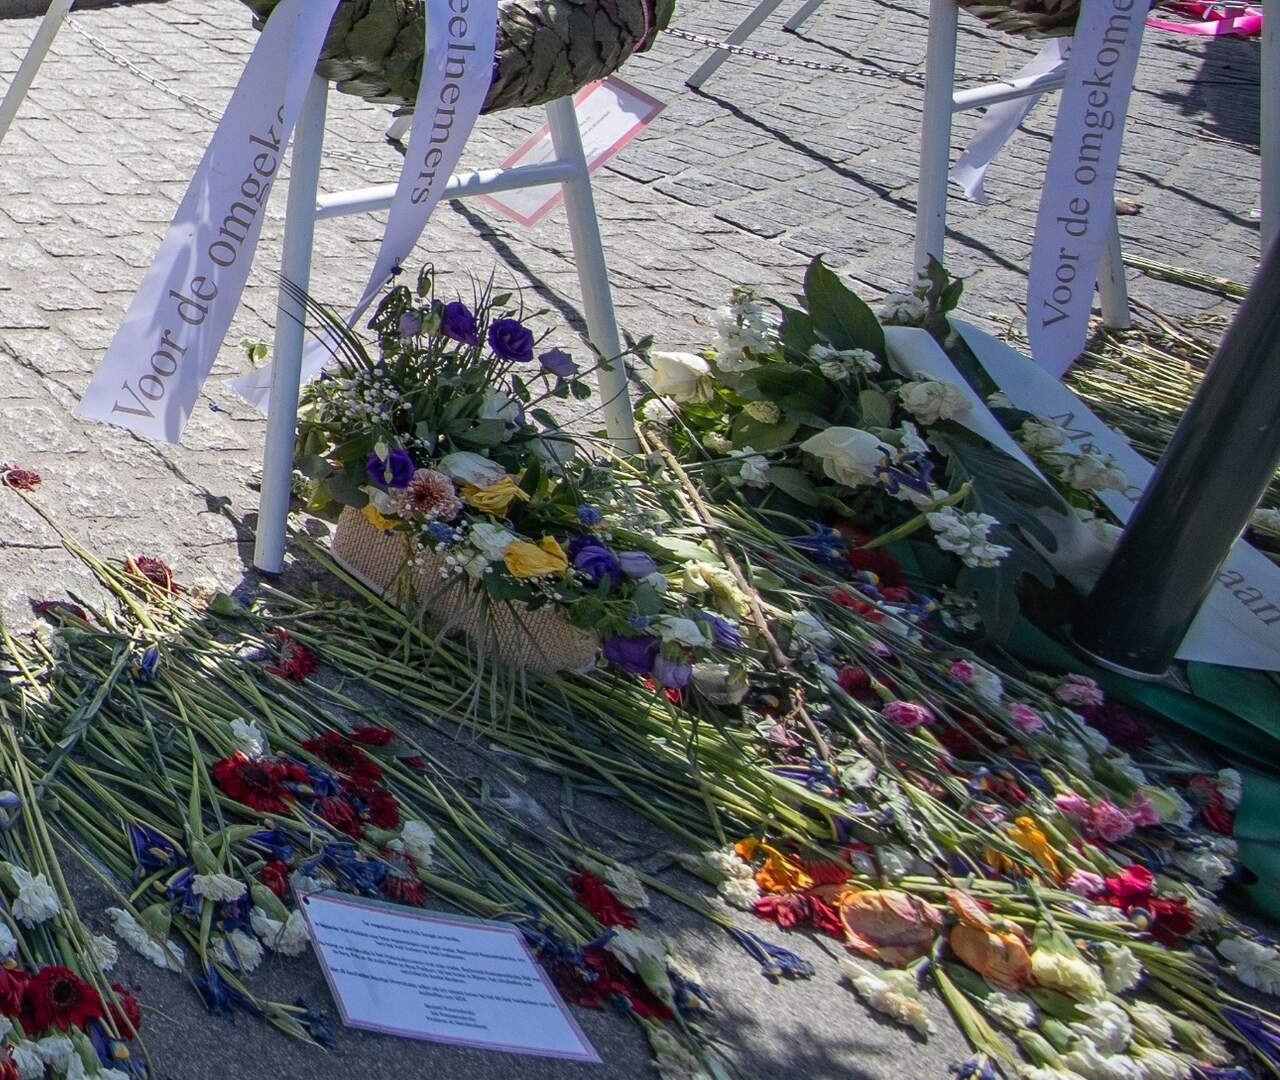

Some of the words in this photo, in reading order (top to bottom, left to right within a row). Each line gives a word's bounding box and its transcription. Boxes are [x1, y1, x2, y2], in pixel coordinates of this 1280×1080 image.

[1057, 196, 1090, 237] de
[1042, 246, 1081, 327] Voor
[111, 328, 189, 419] Voor
[169, 274, 219, 326] de
